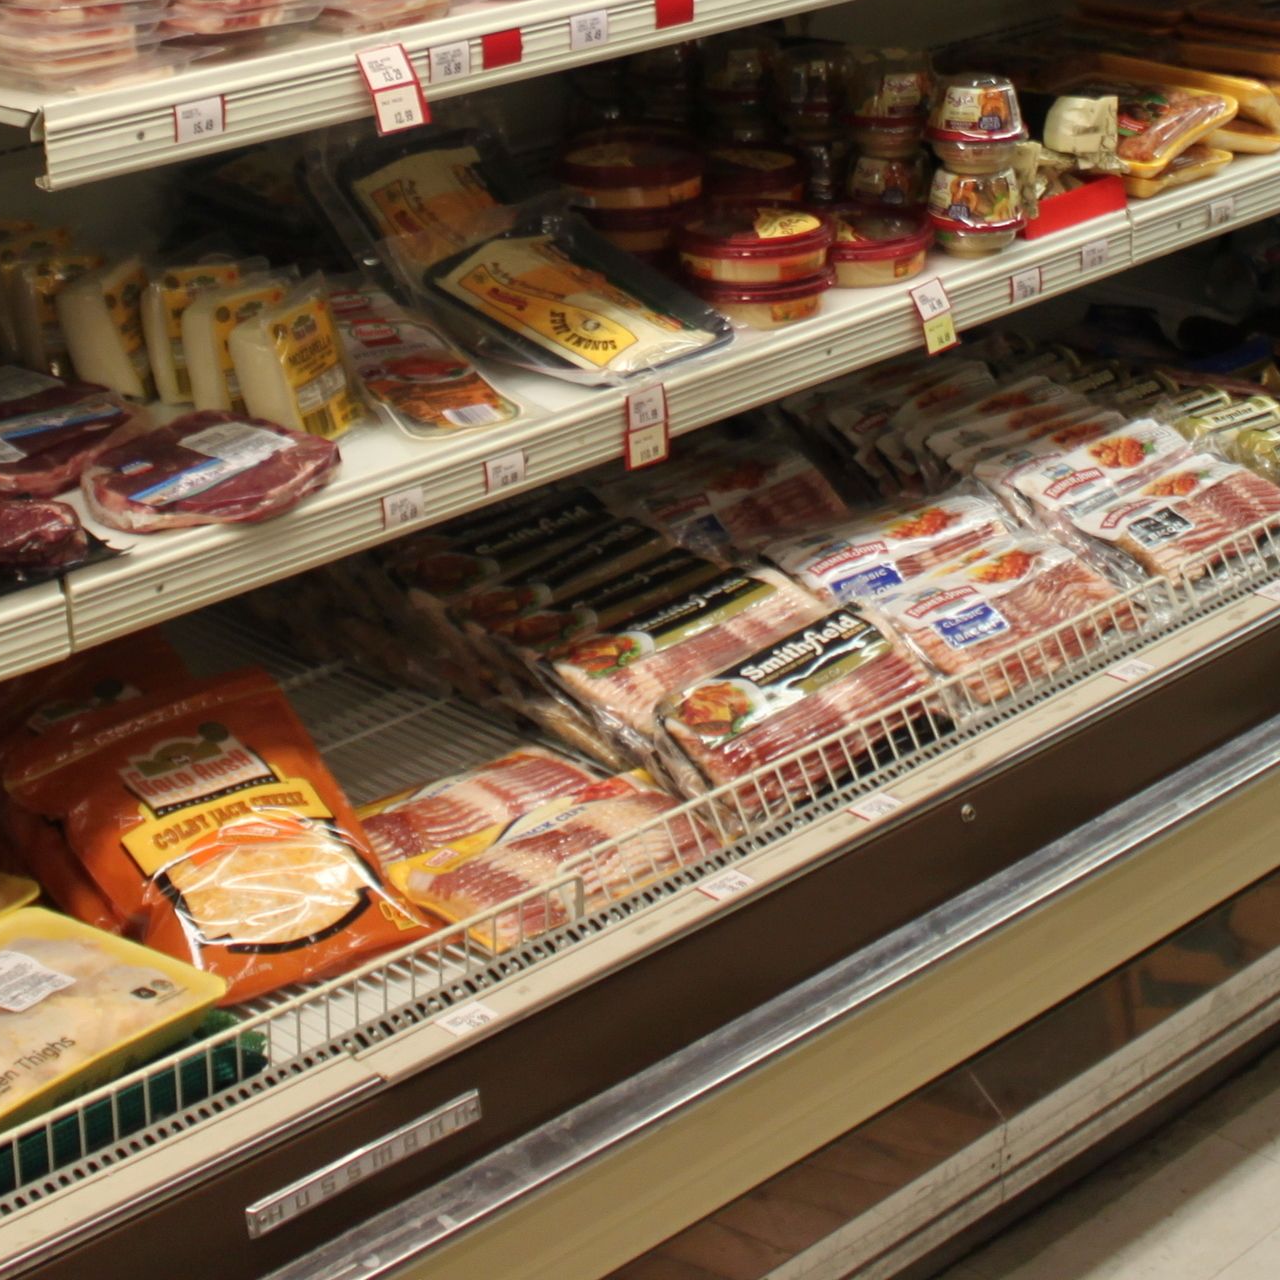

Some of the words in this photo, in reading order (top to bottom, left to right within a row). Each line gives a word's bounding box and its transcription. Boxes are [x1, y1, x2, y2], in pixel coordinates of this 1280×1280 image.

[740, 616, 861, 682] Smithfield
[152, 814, 211, 850] COLBY
[209, 801, 252, 825] JACK
[17, 1034, 78, 1075] Thighs
